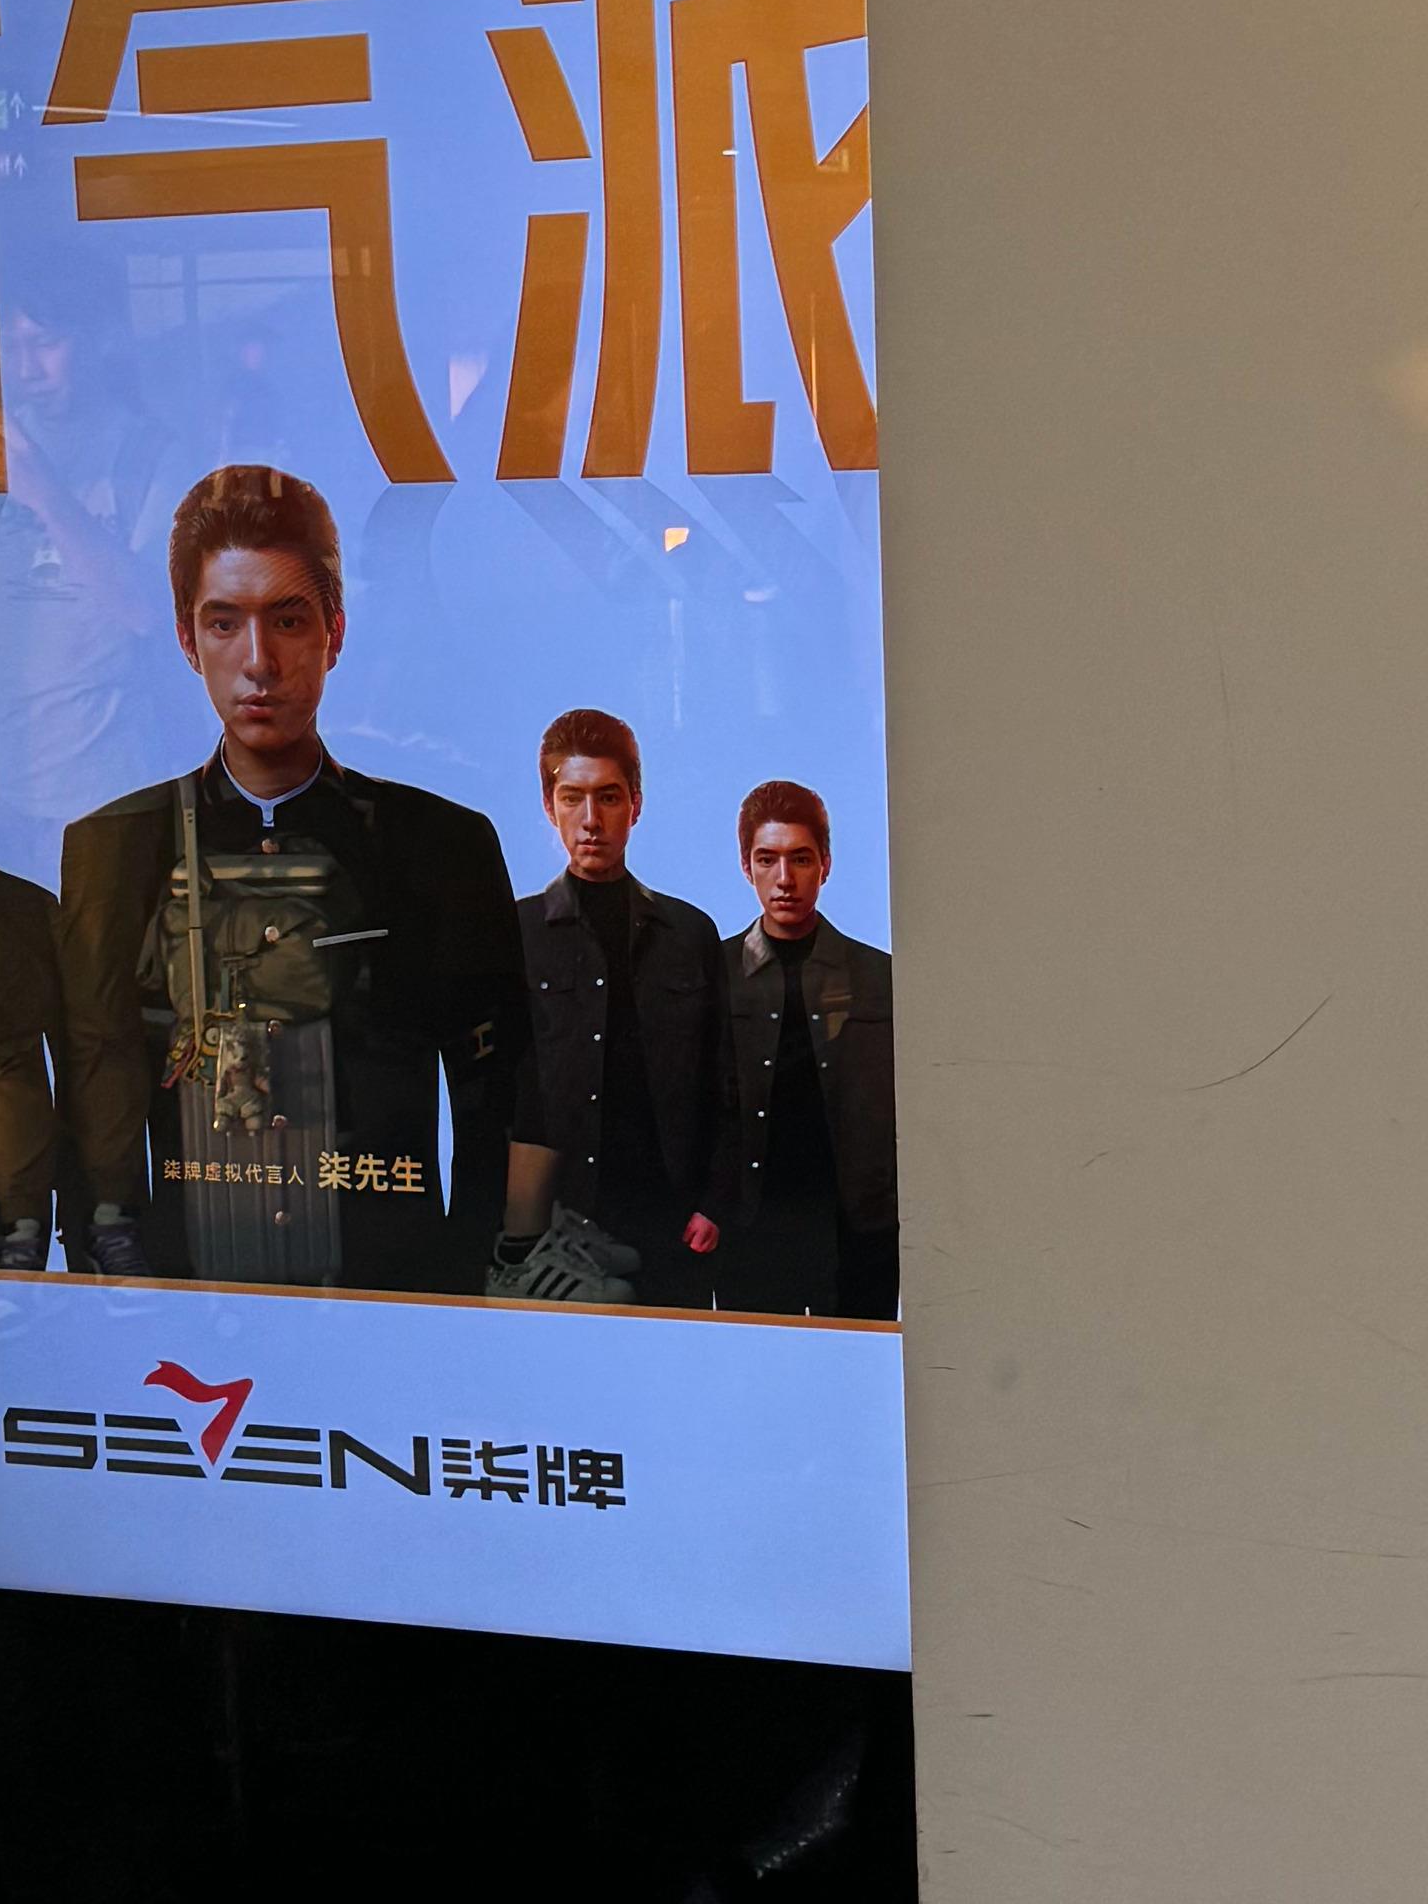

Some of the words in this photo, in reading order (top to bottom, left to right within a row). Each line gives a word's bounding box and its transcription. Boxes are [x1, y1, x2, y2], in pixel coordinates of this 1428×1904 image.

[163, 1158, 305, 1186] 柒牌虚拟代言人
[318, 1150, 426, 1193] 柒先生
[441, 1436, 627, 1510] 柒牌
